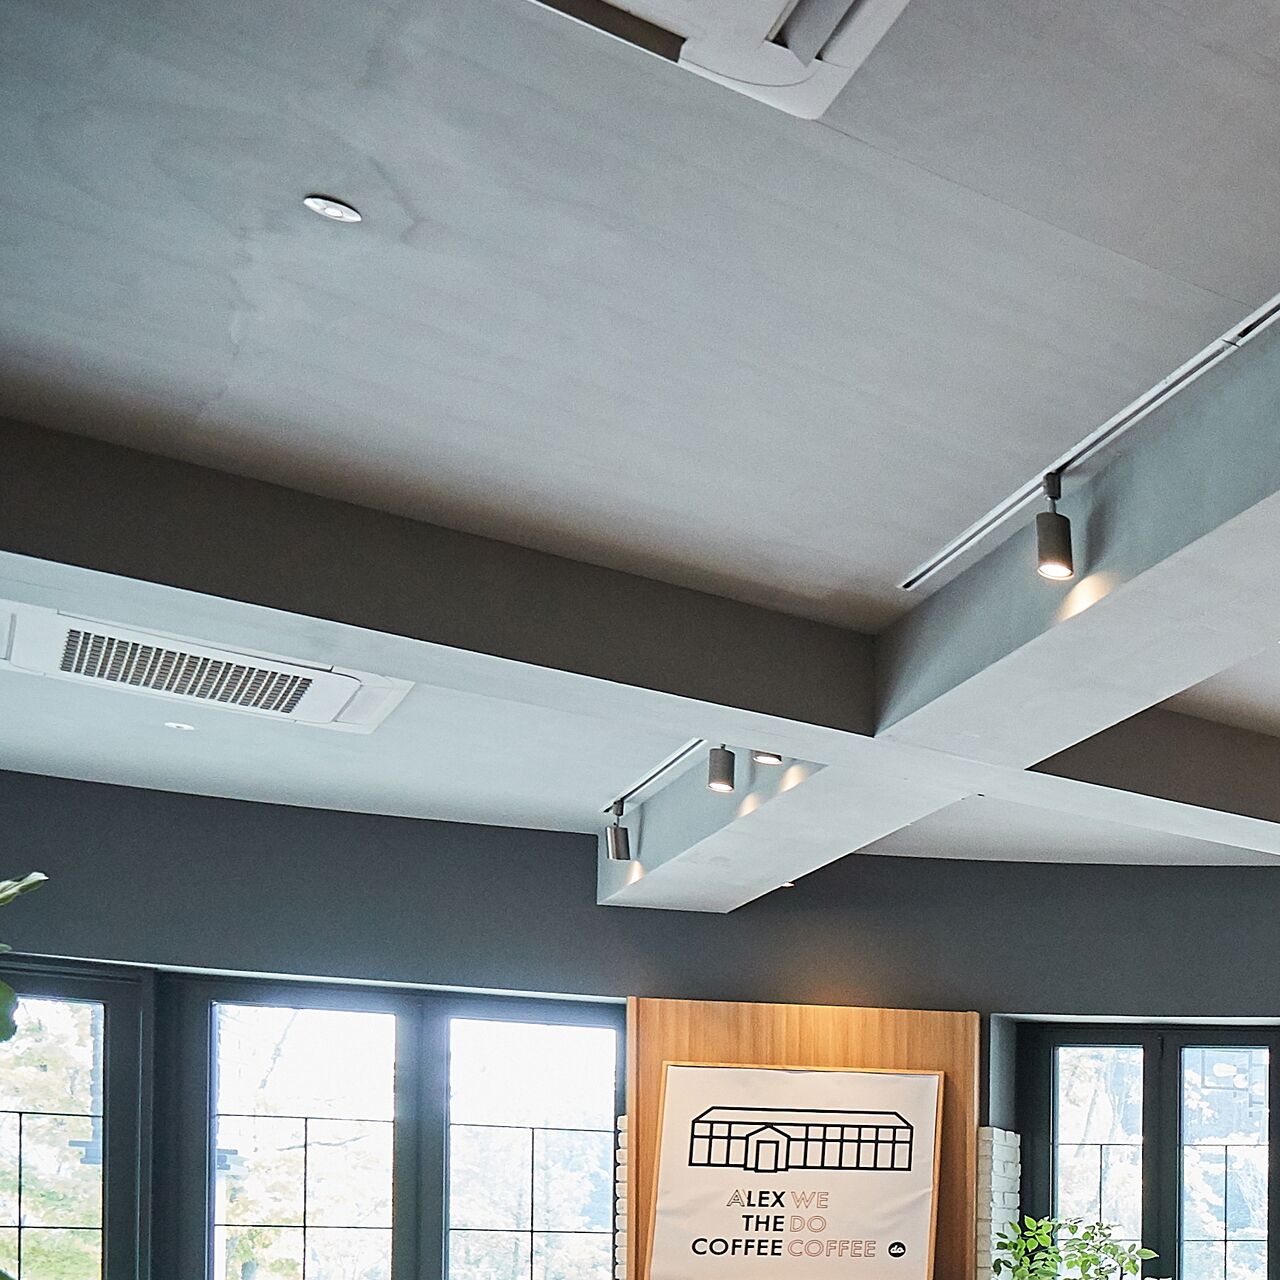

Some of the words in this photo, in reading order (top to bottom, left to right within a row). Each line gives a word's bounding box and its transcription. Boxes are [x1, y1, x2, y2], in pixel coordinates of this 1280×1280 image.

[726, 1189, 786, 1208] ALEX
[791, 1191, 829, 1209] WE
[741, 1214, 785, 1232] THE
[789, 1215, 827, 1233] DO
[691, 1238, 783, 1257] COFFEE
[787, 1239, 876, 1258] COFFEE
